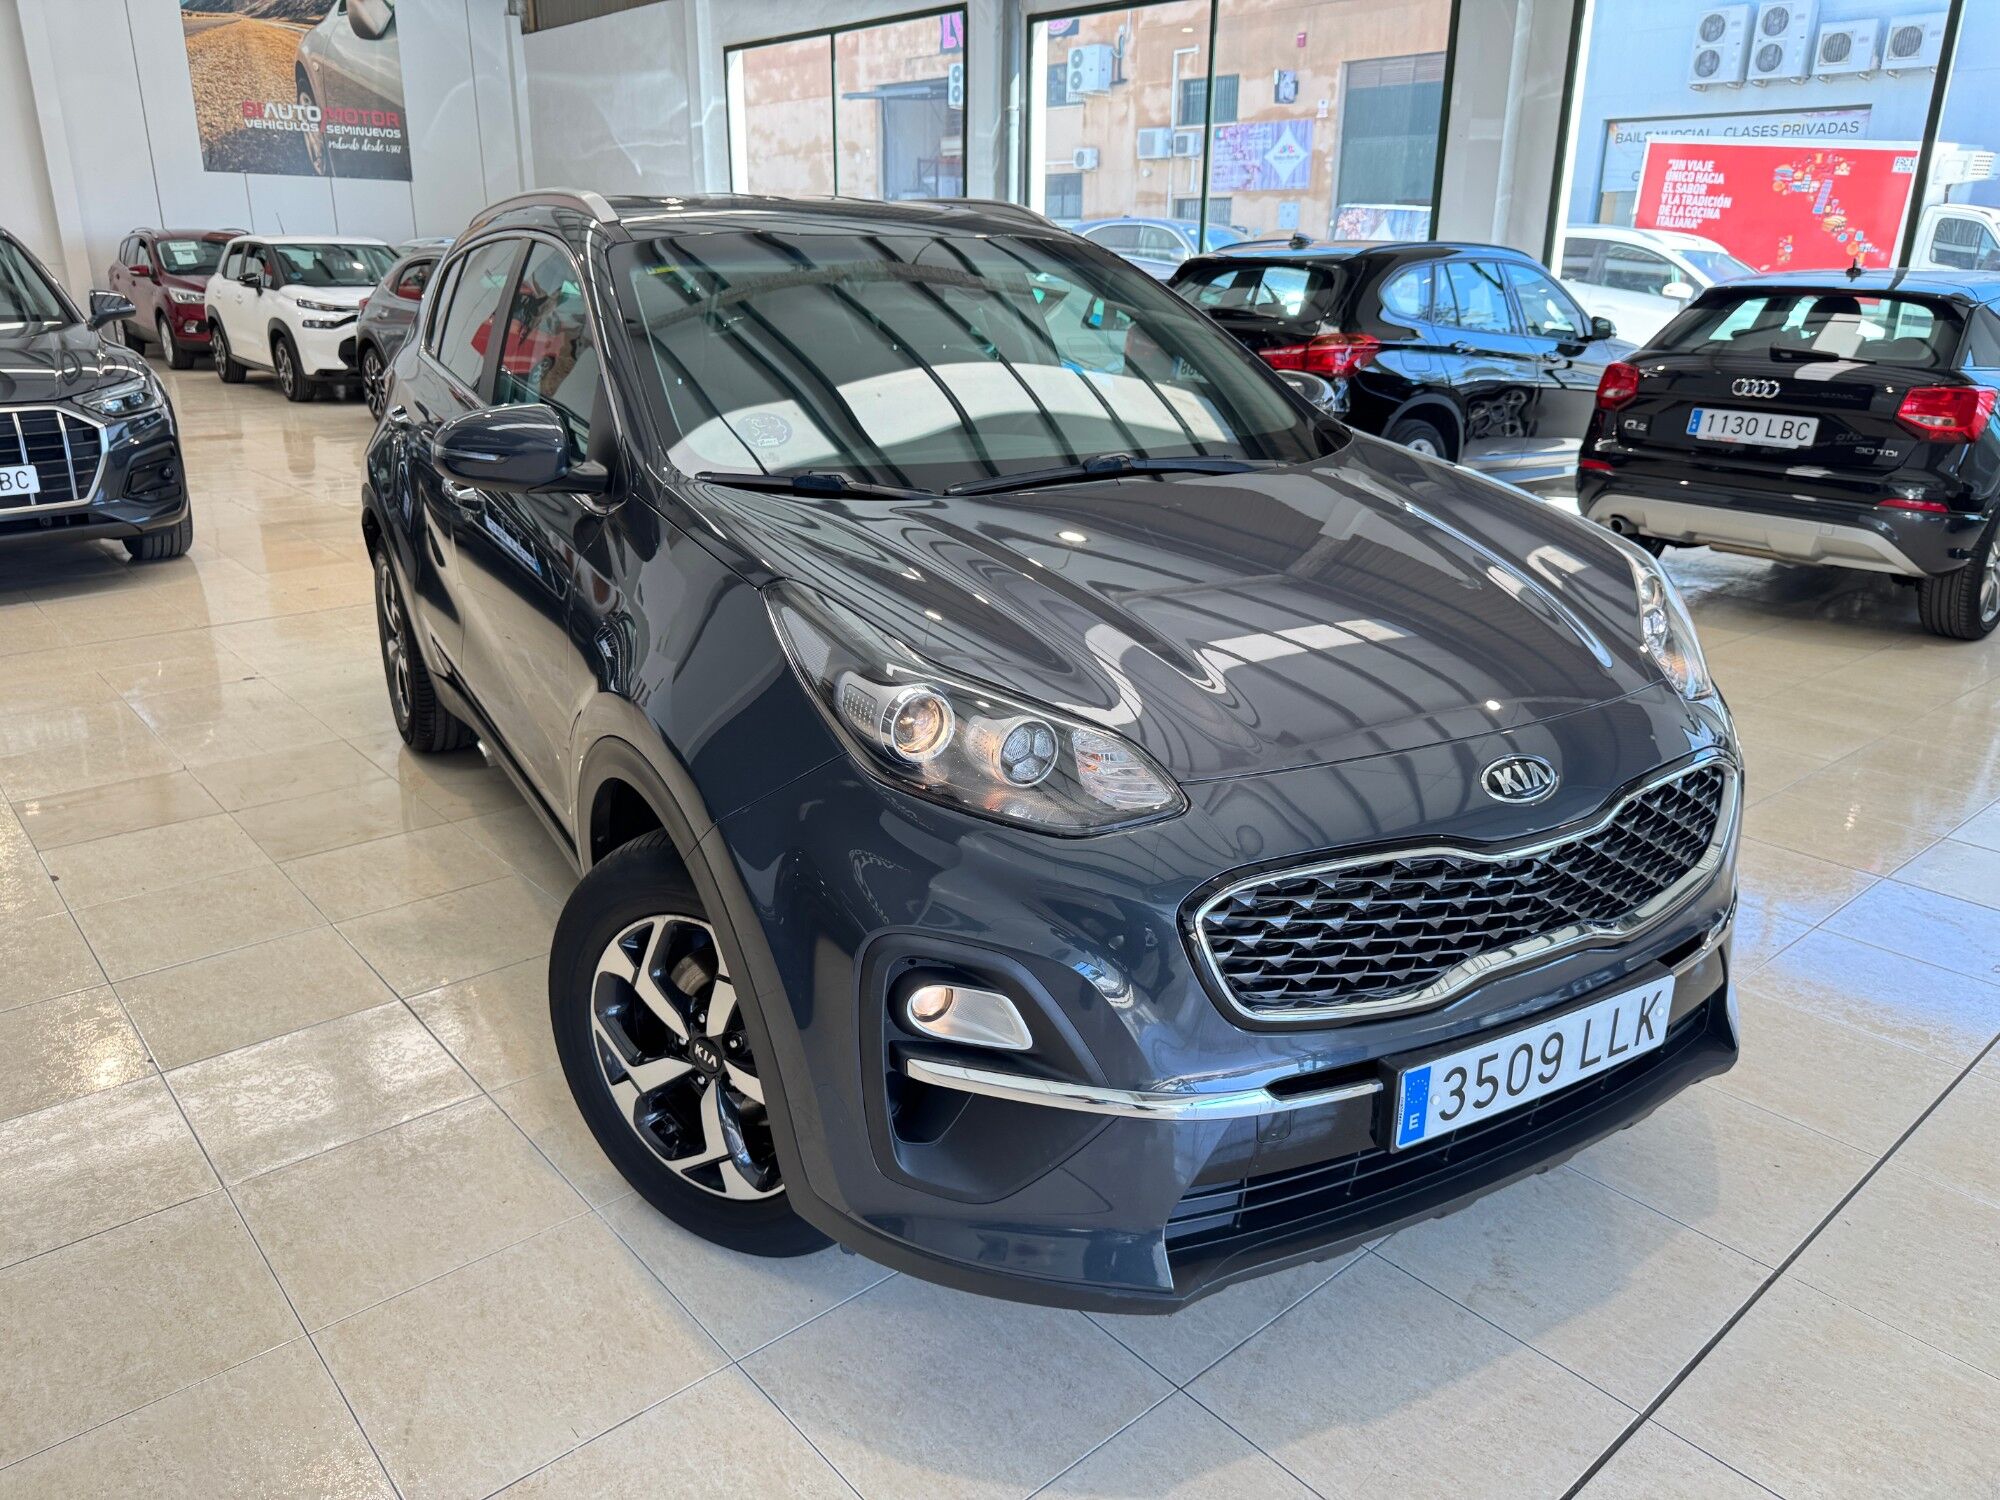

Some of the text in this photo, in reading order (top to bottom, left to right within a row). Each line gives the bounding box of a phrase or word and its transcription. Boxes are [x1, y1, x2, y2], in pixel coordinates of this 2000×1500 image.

[326, 125, 401, 138] SEMINUEVOS
[1723, 124, 1778, 138] CLASES
[1782, 121, 1860, 136] PRIVADAS
[1687, 160, 1715, 172] VIAJE
[1695, 171, 1724, 184] HACIA
[1663, 181, 1707, 195] EL SABOR
[1661, 193, 1732, 208] Y LA TRADICIÓN
[1658, 204, 1720, 219] DE LA COCINA
[1623, 418, 1648, 432] Q2
[1708, 413, 1759, 436] 1130
[1765, 418, 1810, 441] LBC
[1877, 447, 1900, 458] TDI
[1492, 761, 1551, 796] KIA
[694, 1043, 718, 1068] KIA
[1438, 990, 1663, 1122] 3509 LLK
[1409, 1112, 1420, 1130] E
